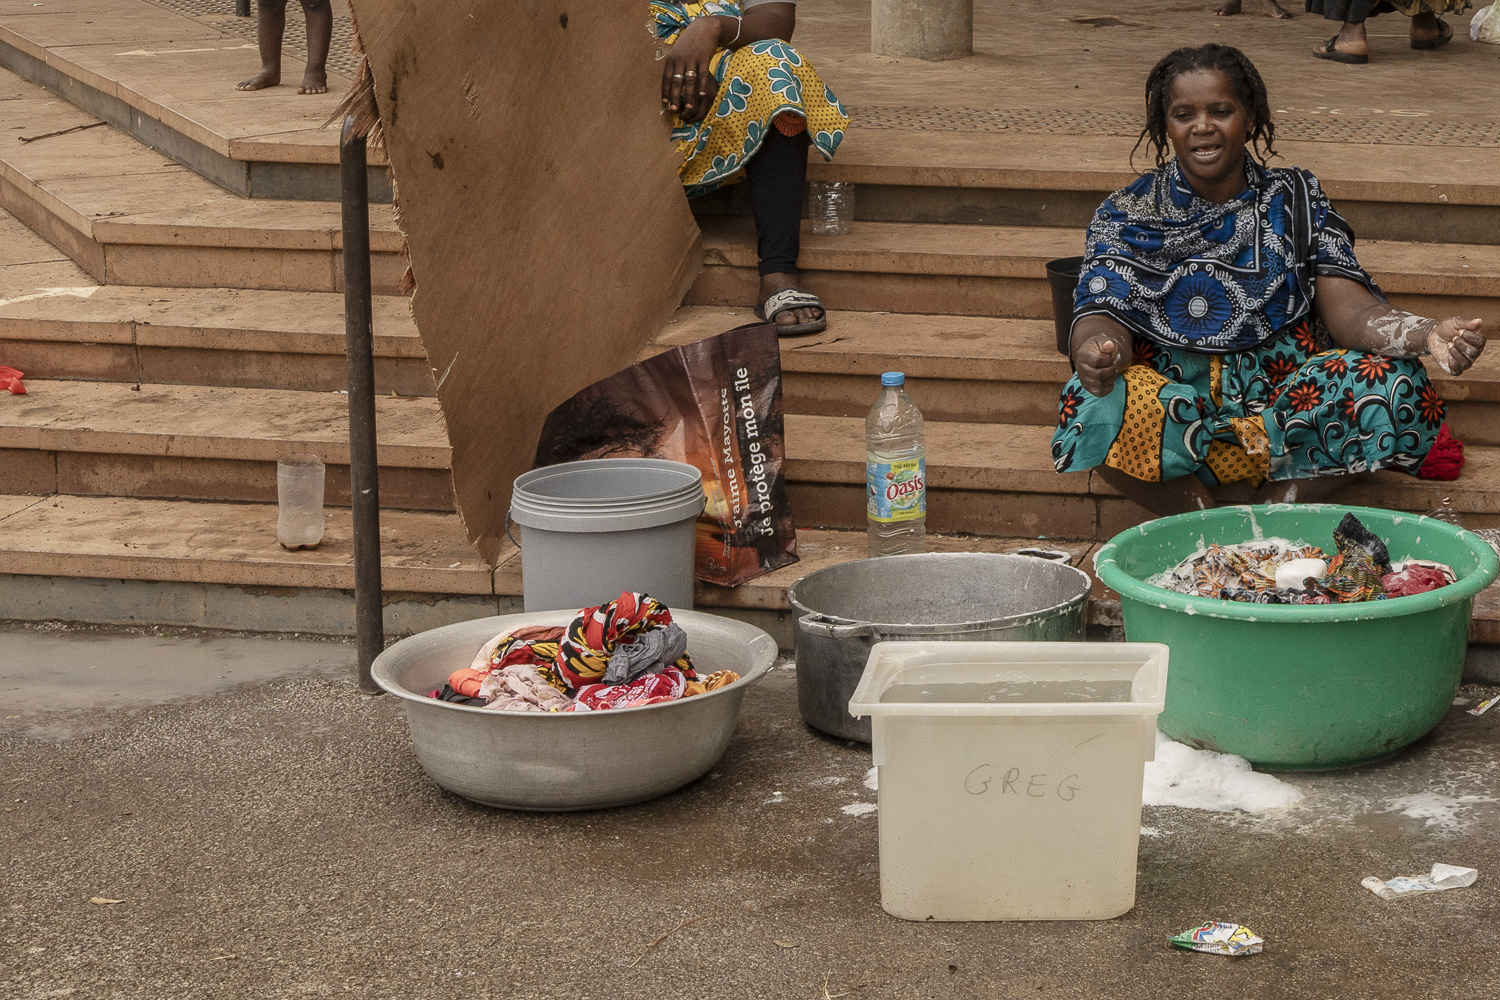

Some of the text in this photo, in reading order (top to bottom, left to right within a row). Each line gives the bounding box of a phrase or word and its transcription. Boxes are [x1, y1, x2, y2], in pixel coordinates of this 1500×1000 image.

[720, 387, 734, 464] Mayotte
[734, 367, 774, 537] Je protège mon île
[886, 475, 924, 500] Oasis
[964, 763, 1084, 802] GREG
